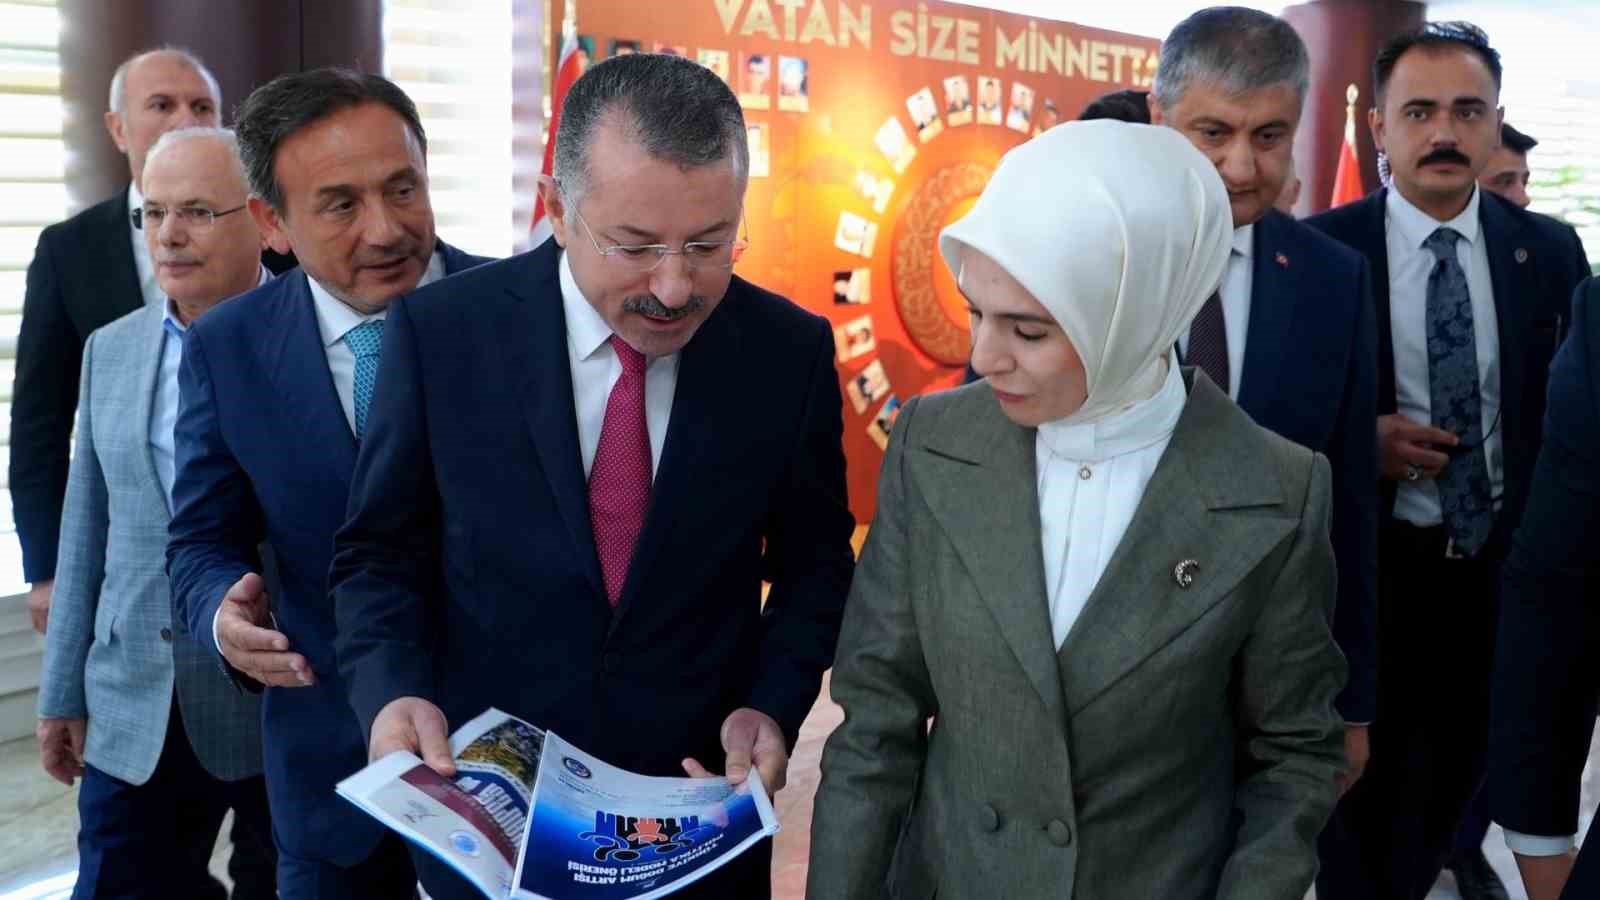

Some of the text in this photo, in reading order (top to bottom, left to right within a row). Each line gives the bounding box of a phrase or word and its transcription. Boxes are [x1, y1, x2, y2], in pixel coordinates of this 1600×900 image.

[713, 0, 872, 50] VATAN
[890, 4, 981, 65] SİZE
[567, 859, 618, 876] ÖNERİSİ
[621, 860, 668, 875] MODELİ
[573, 872, 617, 885] ARTIŞI
[620, 868, 665, 884] DOĞUM
